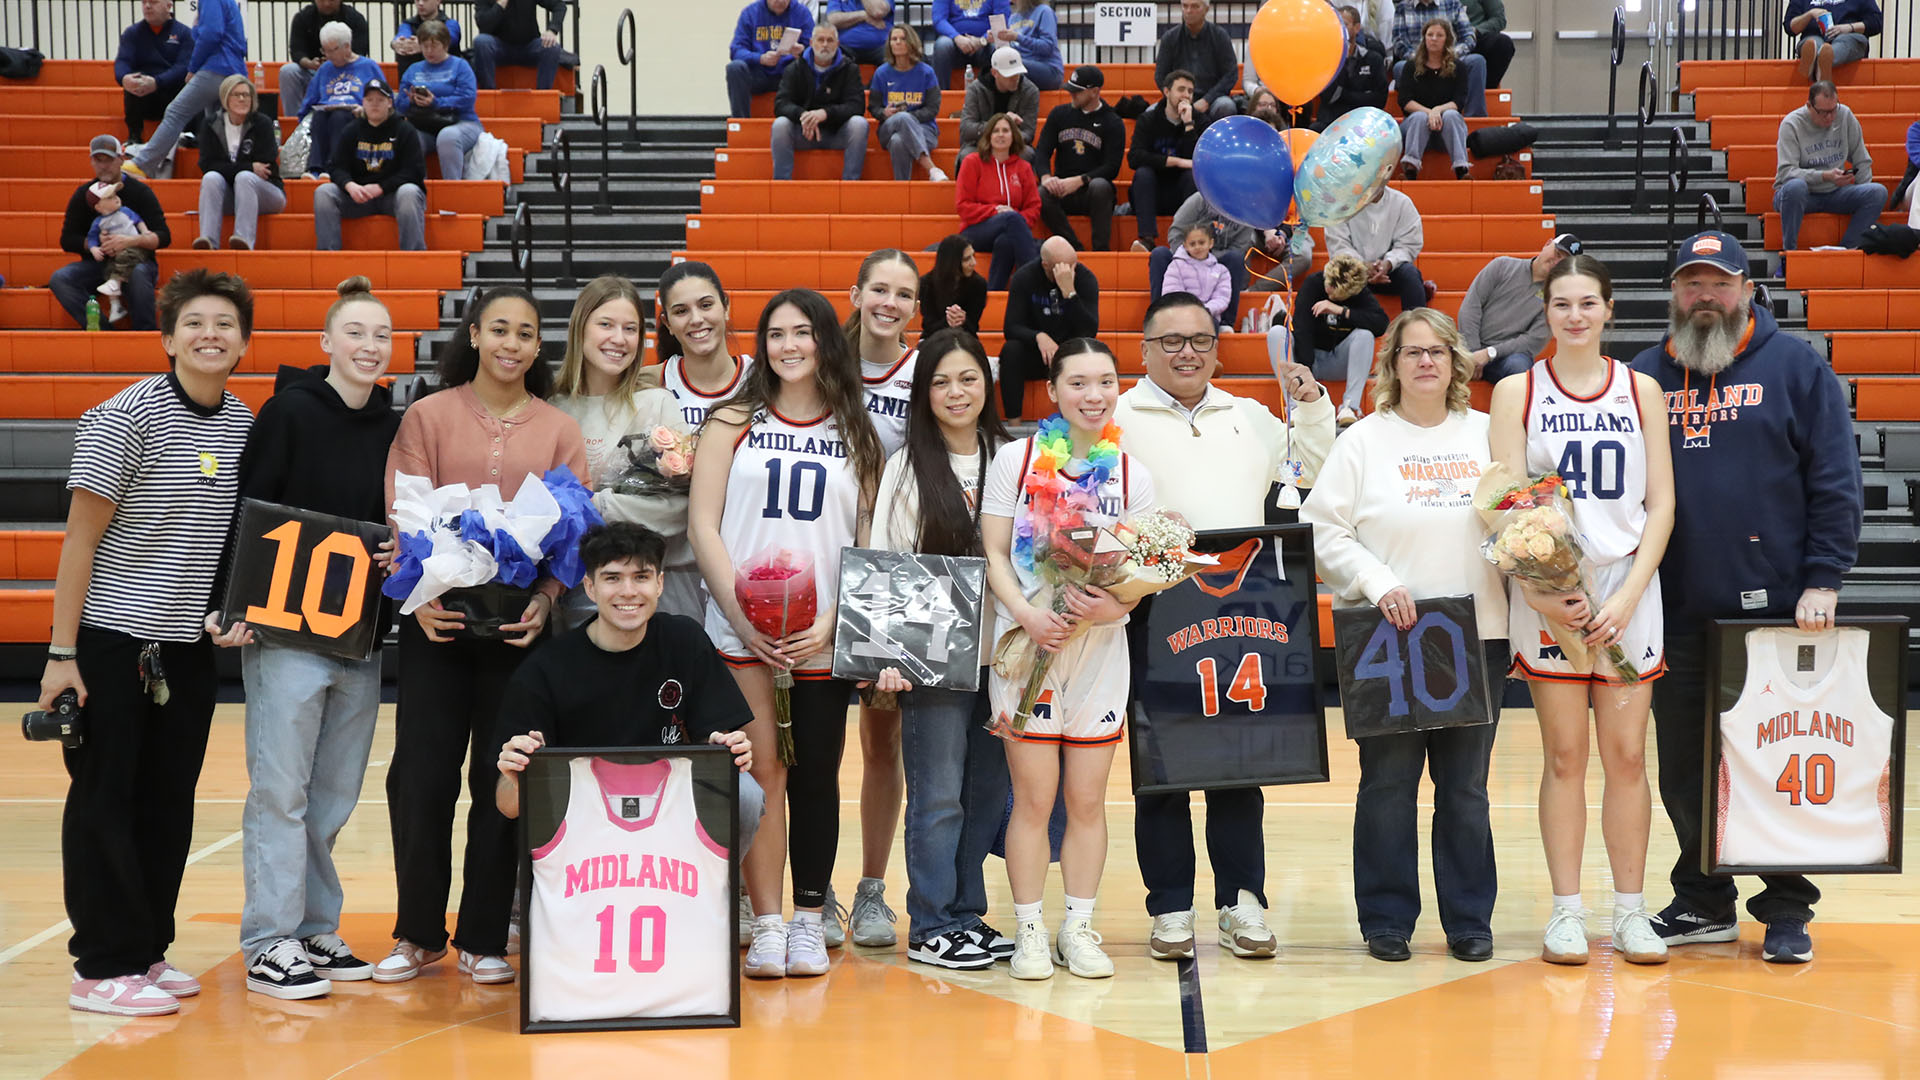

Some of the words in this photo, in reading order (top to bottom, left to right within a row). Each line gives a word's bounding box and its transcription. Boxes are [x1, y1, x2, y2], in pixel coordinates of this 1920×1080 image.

[1100, 6, 1151, 17] SECTION
[1119, 21, 1132, 41] F
[1662, 383, 1764, 413] IDLAND
[748, 430, 848, 459] MIDLAND
[1540, 412, 1635, 433] MIDLAND
[762, 458, 827, 521] 10
[1398, 459, 1482, 481] WARRIORS
[1556, 440, 1626, 500] 40
[245, 520, 371, 639] 10
[851, 572, 953, 664] 14
[1167, 615, 1289, 655] WARRIORS
[1196, 652, 1267, 717] 14
[1354, 611, 1470, 717] 40
[1757, 710, 1854, 750] MIDLAND
[1776, 753, 1836, 806] 40
[564, 853, 698, 899] MIDLAND
[594, 904, 667, 973] 10
